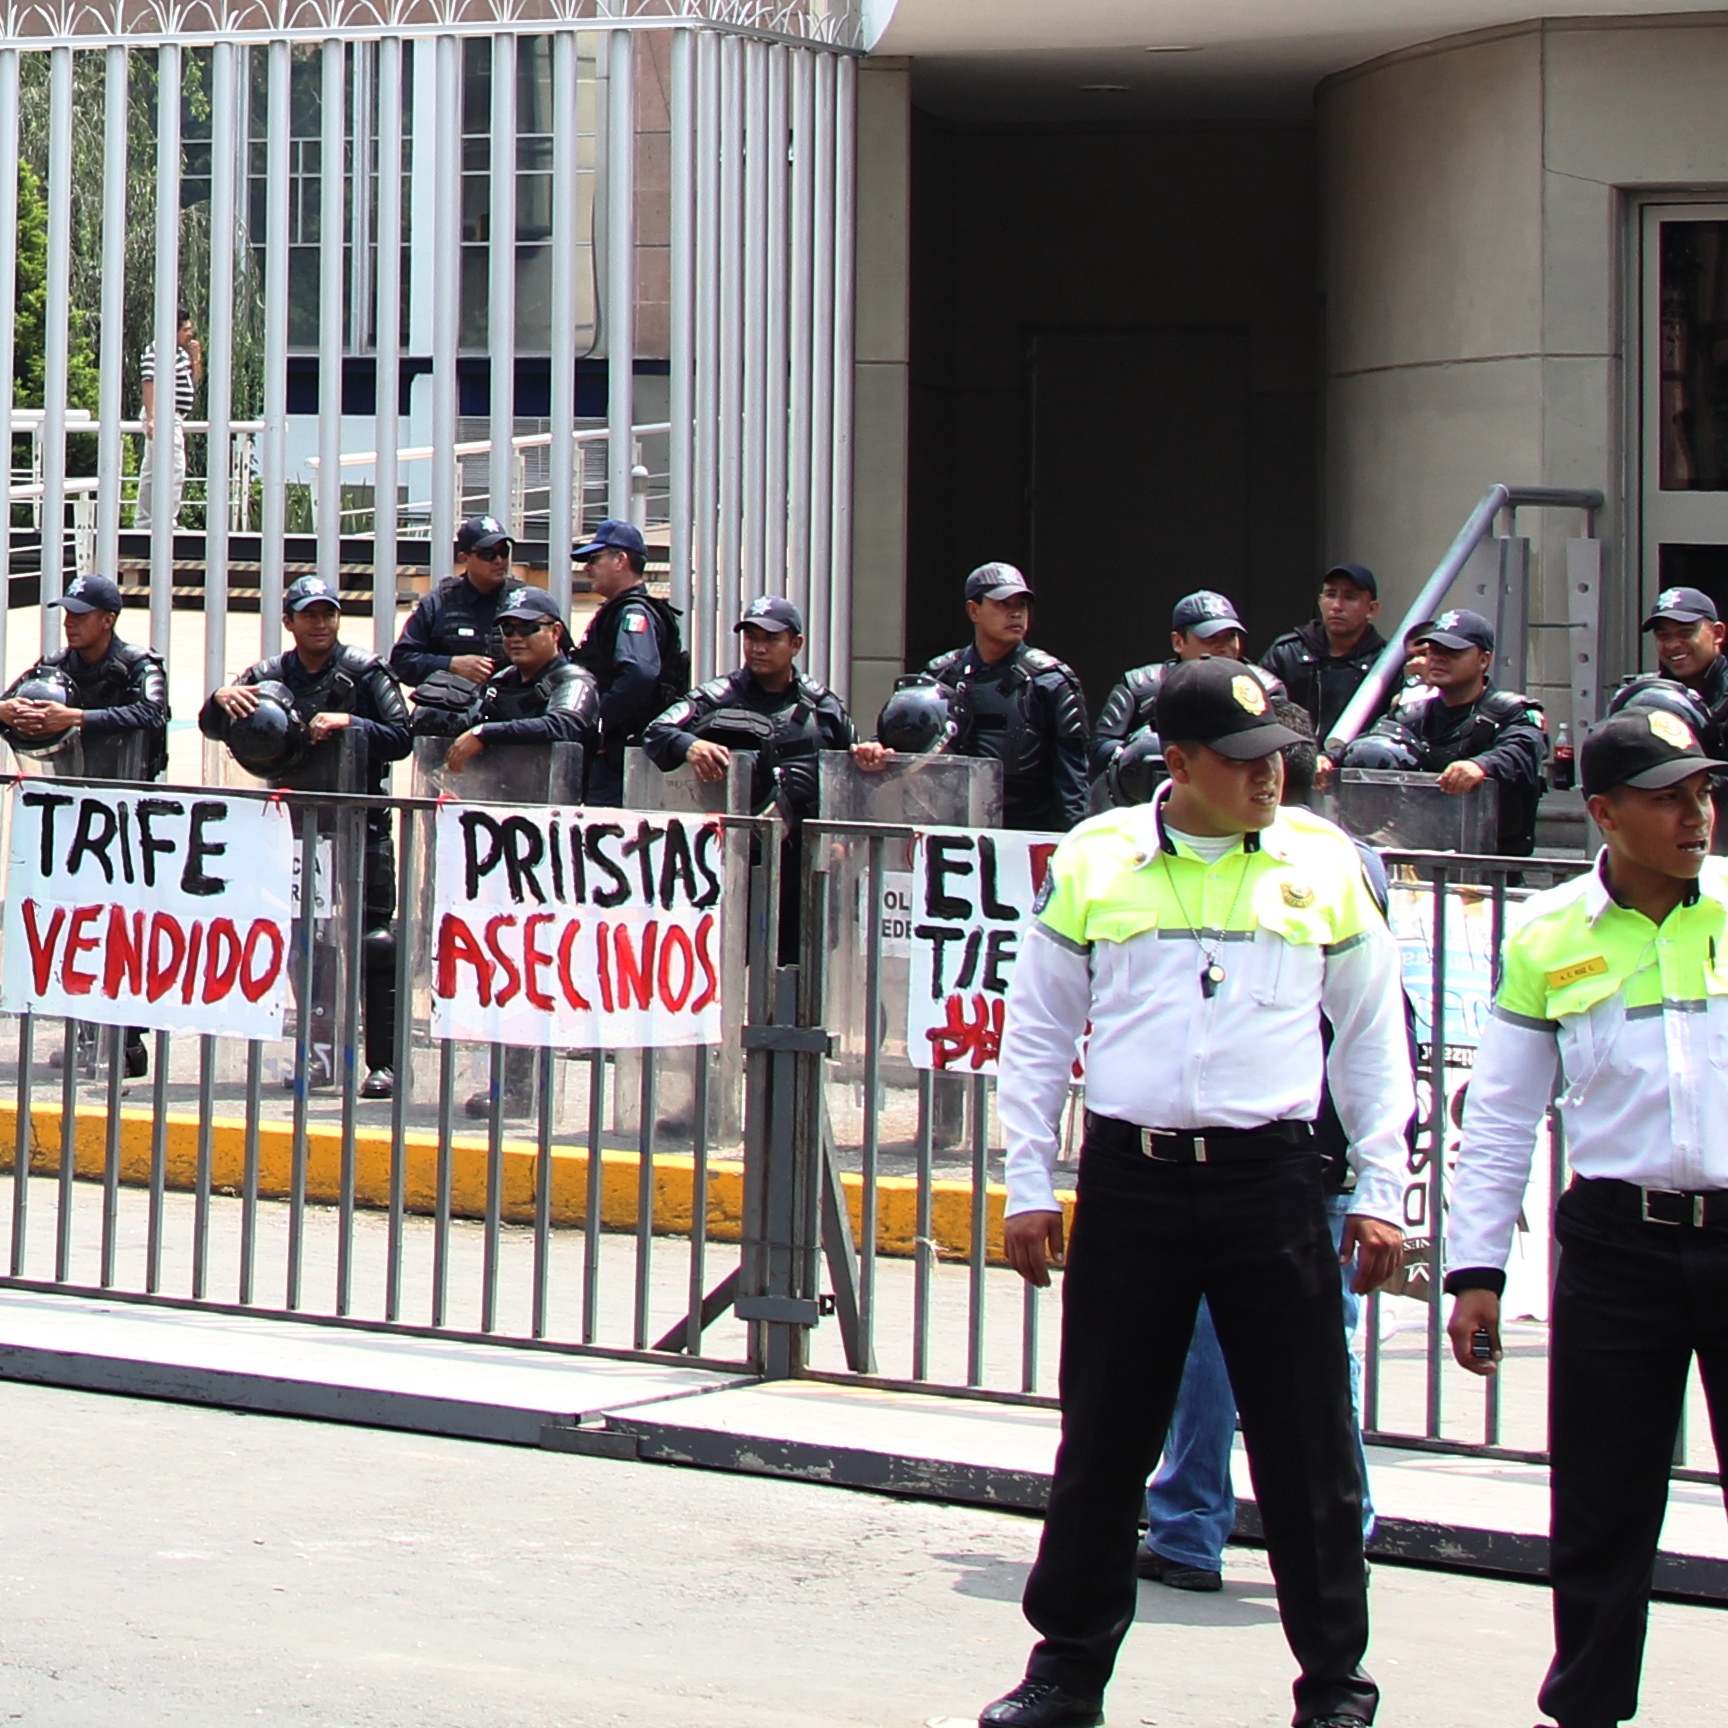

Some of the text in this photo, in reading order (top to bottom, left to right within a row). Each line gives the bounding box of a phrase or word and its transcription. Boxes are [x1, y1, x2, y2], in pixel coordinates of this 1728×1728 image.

[22, 792, 229, 896] TRIFE
[925, 835, 1020, 921] EL
[21, 897, 285, 1005] VENDIDO
[437, 912, 718, 1014] ASECINOS
[914, 925, 1018, 1005] TIE
